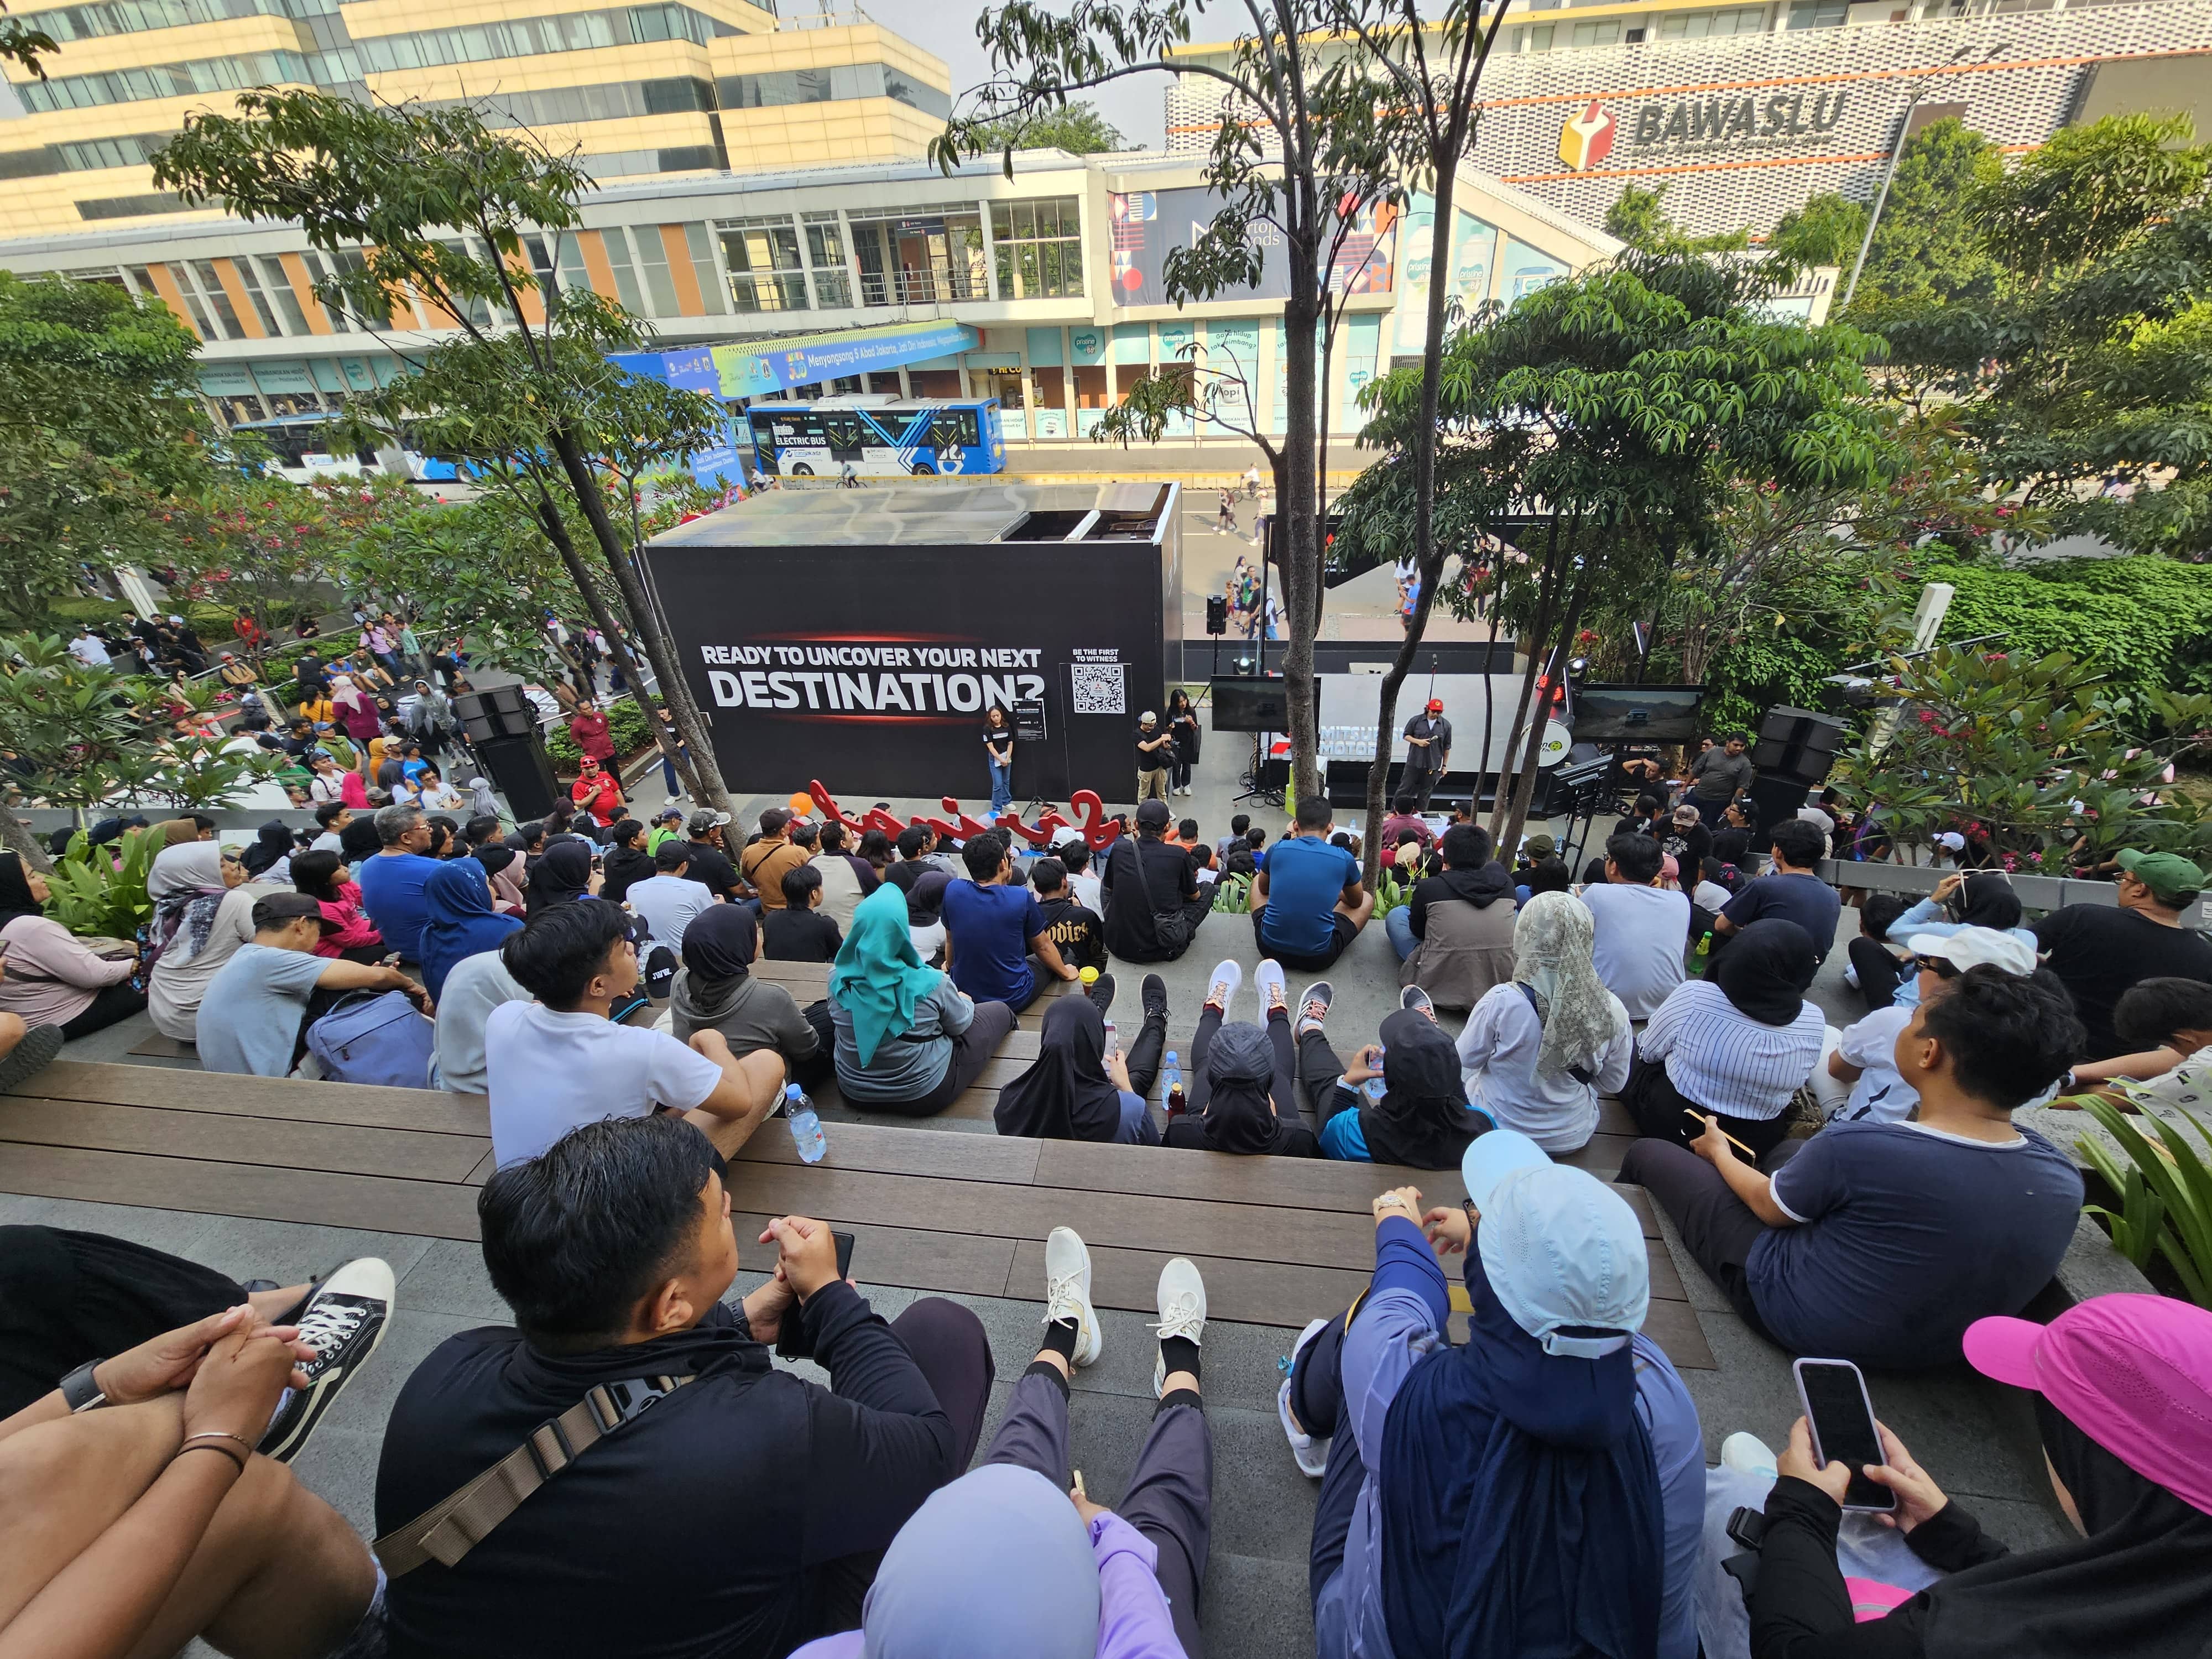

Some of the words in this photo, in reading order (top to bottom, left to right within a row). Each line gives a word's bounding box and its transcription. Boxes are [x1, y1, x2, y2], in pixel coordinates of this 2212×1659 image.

[1632, 90, 1848, 144] BAWASLU
[807, 352, 854, 368] Menyongsong
[860, 347, 875, 358] Abad
[775, 437, 810, 445] ELECTRIC
[701, 646, 771, 665] READY
[773, 646, 805, 665] TO
[806, 647, 912, 666] UNCOVER
[912, 648, 978, 667] YOUR
[980, 648, 1041, 668] NEXT
[707, 671, 1045, 712] DESTINATION?
